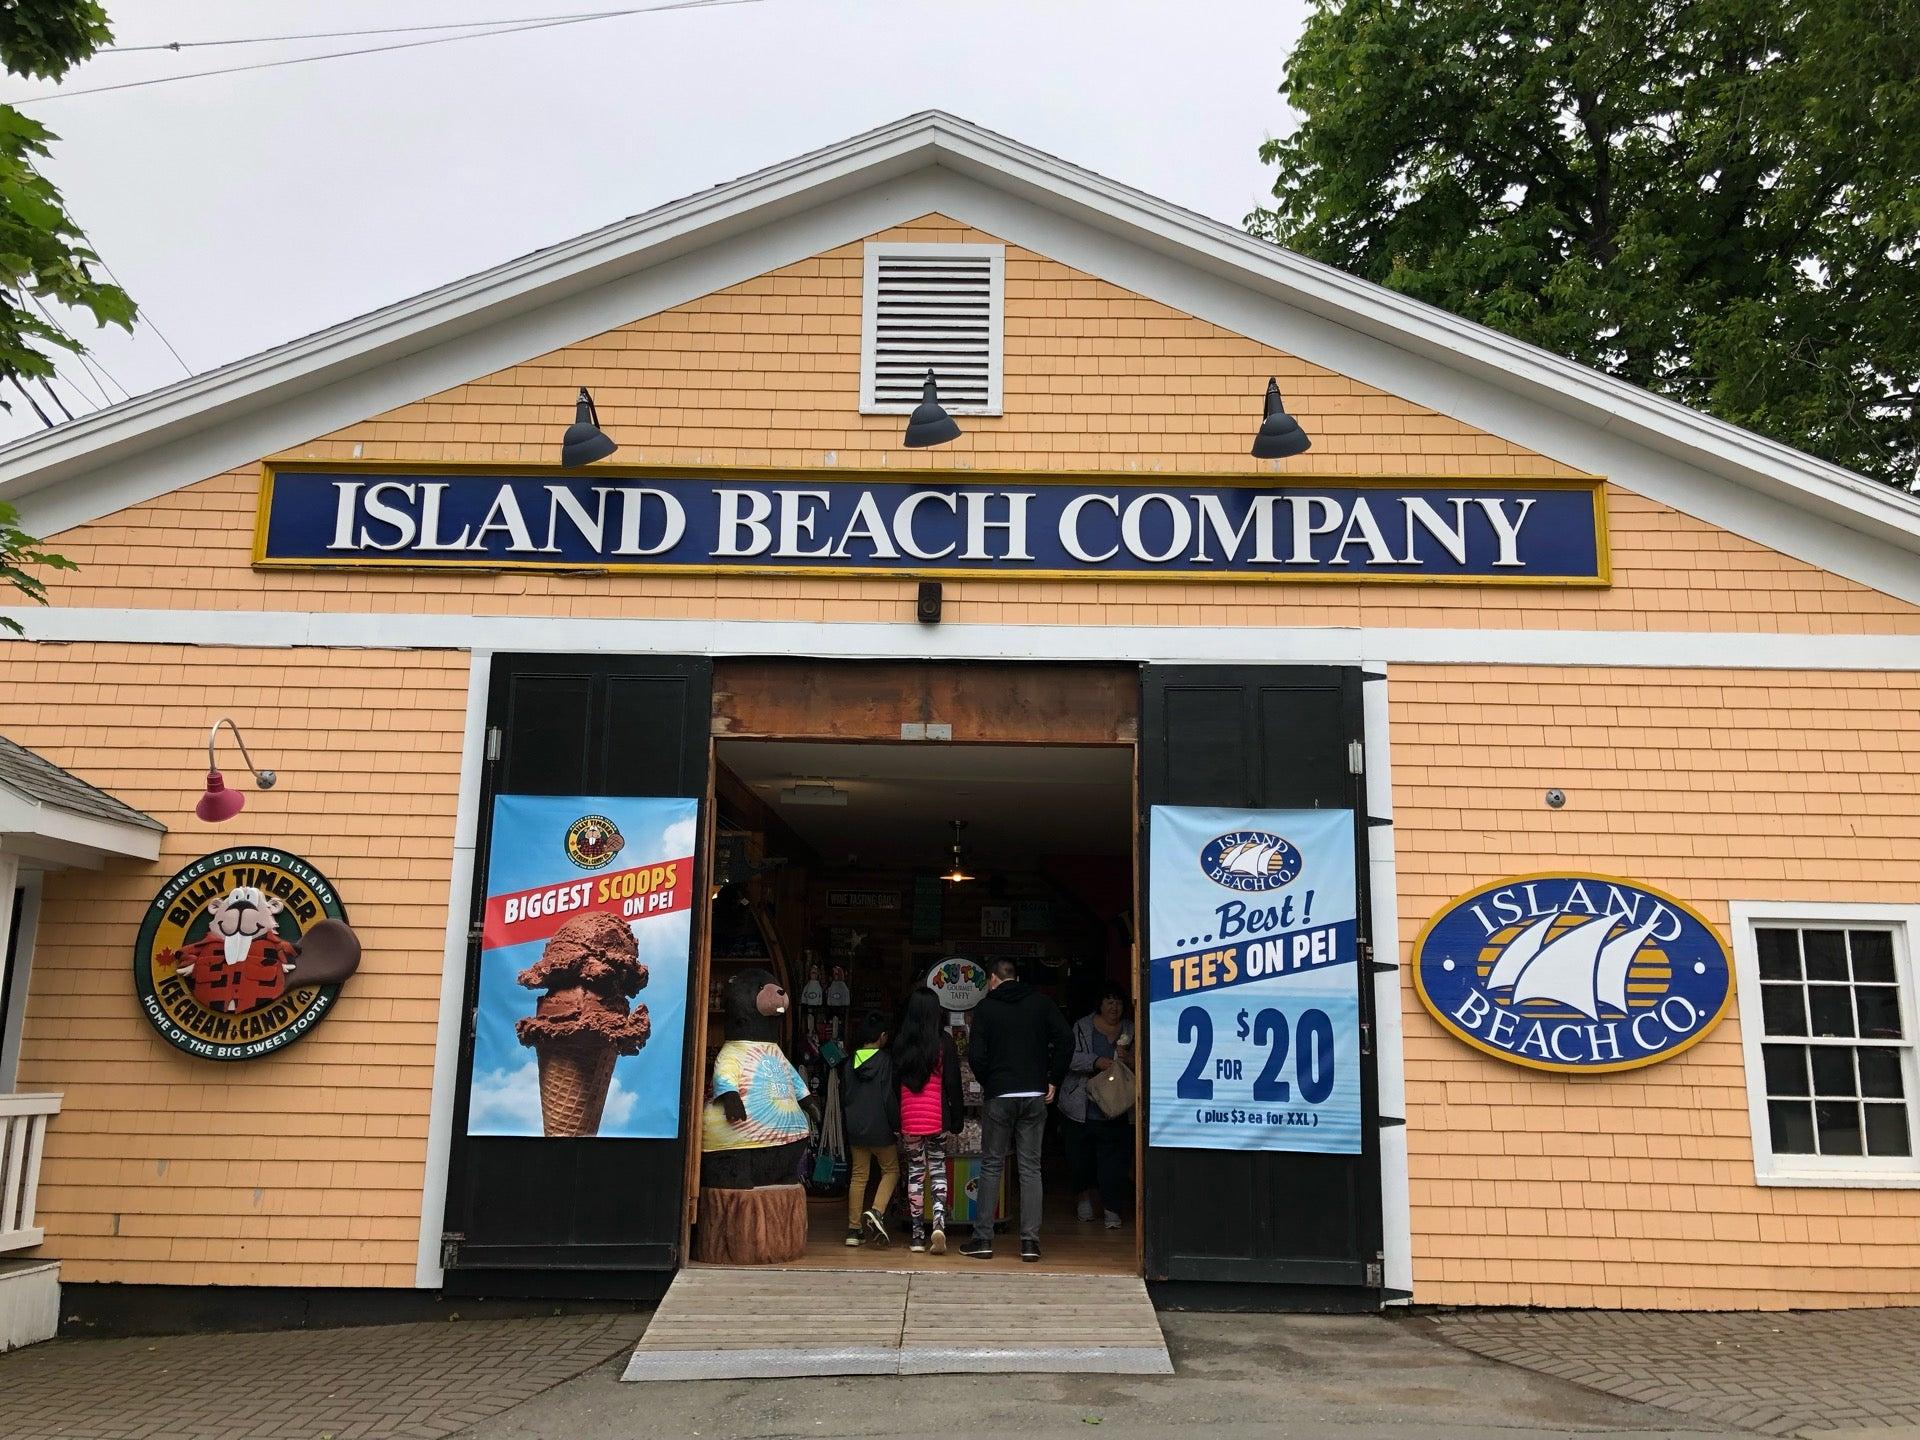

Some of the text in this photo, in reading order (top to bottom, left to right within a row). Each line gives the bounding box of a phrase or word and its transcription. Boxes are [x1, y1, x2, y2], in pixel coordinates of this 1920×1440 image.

[326, 481, 1537, 566] ISLAND BEACH COMPANY
[1216, 830, 1289, 855] ISLAND
[157, 851, 332, 910] PRINCE EDWARD ISLAND
[168, 868, 317, 929] BILLY TIMBER
[504, 864, 678, 924] BIGGEST SCOOPS
[623, 890, 674, 917] ON PEI
[1209, 868, 1296, 891] BEACH CO.
[1469, 881, 1682, 942] ISLAND
[1169, 928, 1337, 993] TEE'S ON PEI
[144, 994, 328, 1057] HOME OF THE BIG SWEET TOOTH
[158, 977, 184, 1006] ICE
[177, 997, 233, 1040] CREAM
[239, 997, 299, 1039] CANDY
[296, 990, 313, 1007] CO.
[1451, 987, 1705, 1061] BEACH CO.
[1177, 1005, 1335, 1105] 2 FOR $20
[1231, 1110, 1246, 1126] $3
[1248, 1113, 1263, 1125] ea
[1266, 1111, 1284, 1125] for
